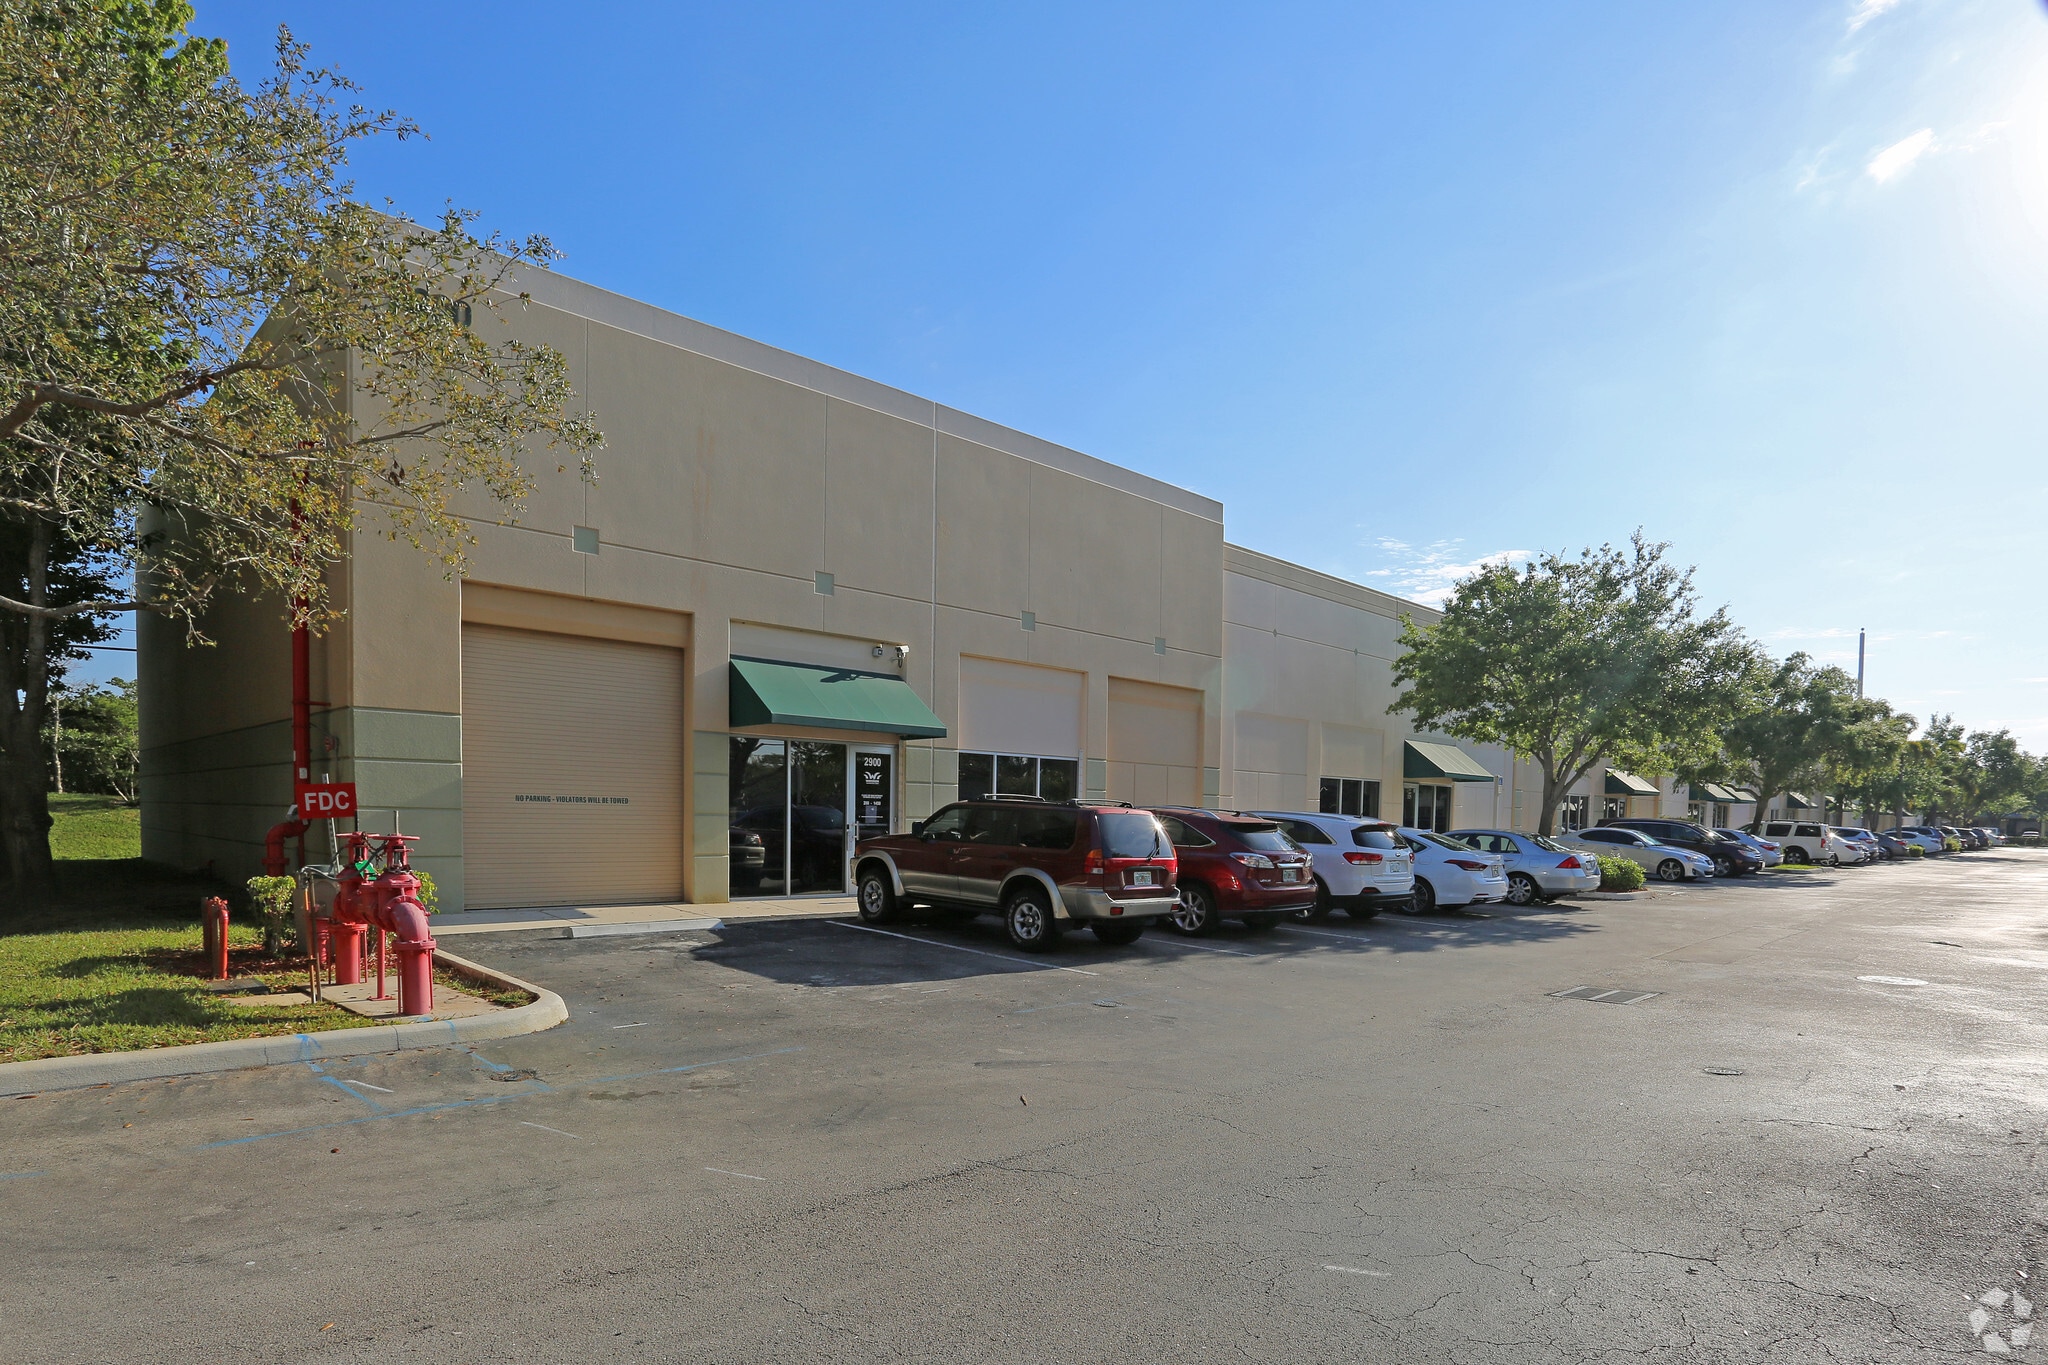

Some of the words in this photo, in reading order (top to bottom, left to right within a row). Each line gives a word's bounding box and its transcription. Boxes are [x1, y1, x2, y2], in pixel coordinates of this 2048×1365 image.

[864, 757, 881, 767] 2900
[304, 791, 350, 811] FDC
[525, 795, 551, 803] PARKING
[556, 795, 586, 804] VIOLATORS
[588, 796, 601, 804] WILL
[602, 796, 609, 804] BE
[610, 797, 629, 805] TOWED
